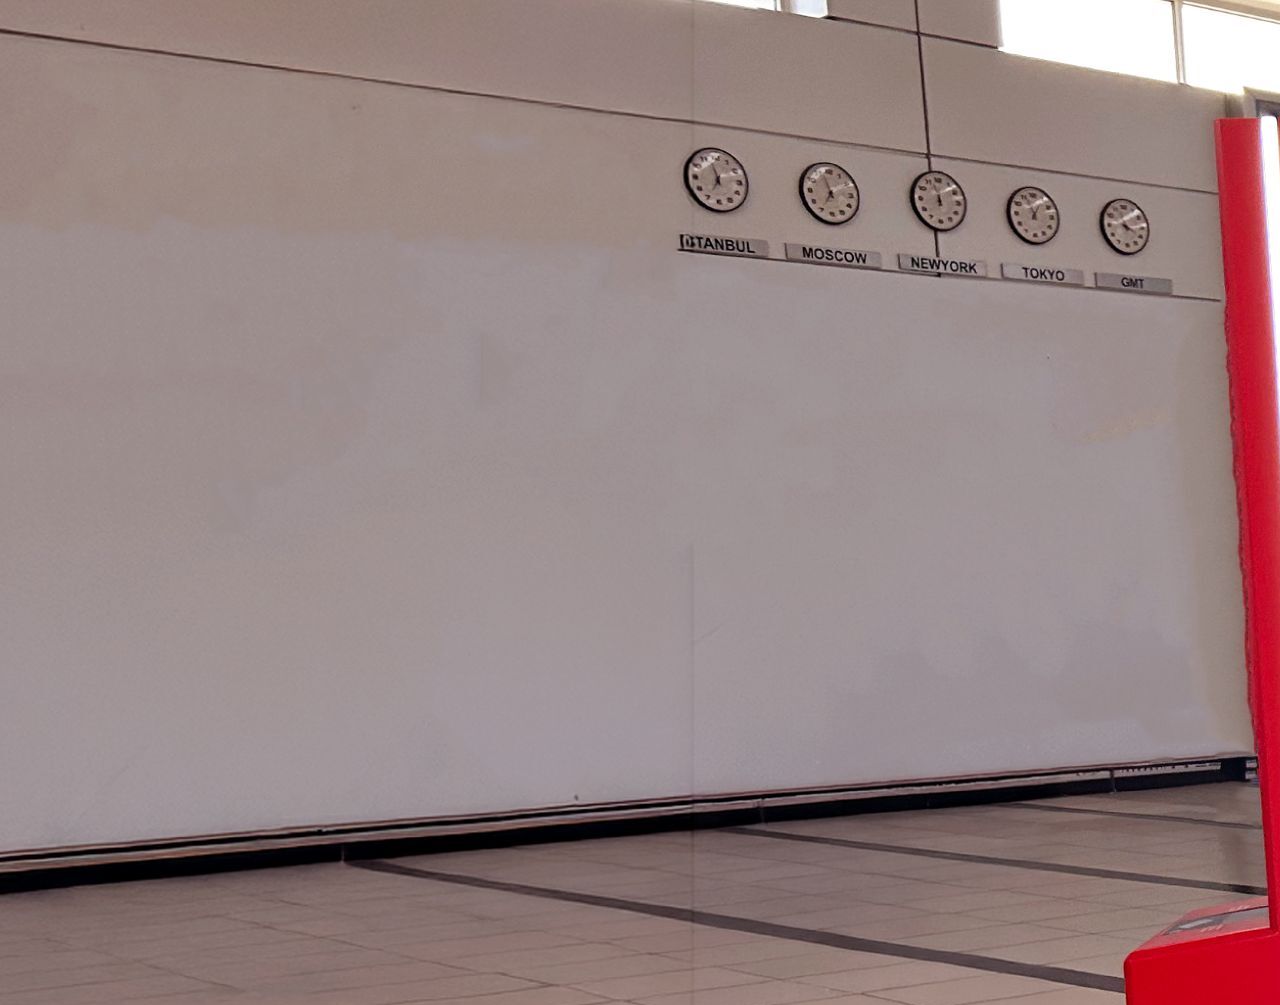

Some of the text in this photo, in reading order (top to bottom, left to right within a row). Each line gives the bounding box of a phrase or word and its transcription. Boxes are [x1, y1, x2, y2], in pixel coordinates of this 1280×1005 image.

[802, 246, 867, 264] MOSCOW
[911, 256, 977, 274] NEWYORK
[1022, 267, 1065, 281] TOKYO
[1121, 276, 1144, 289] GMT
